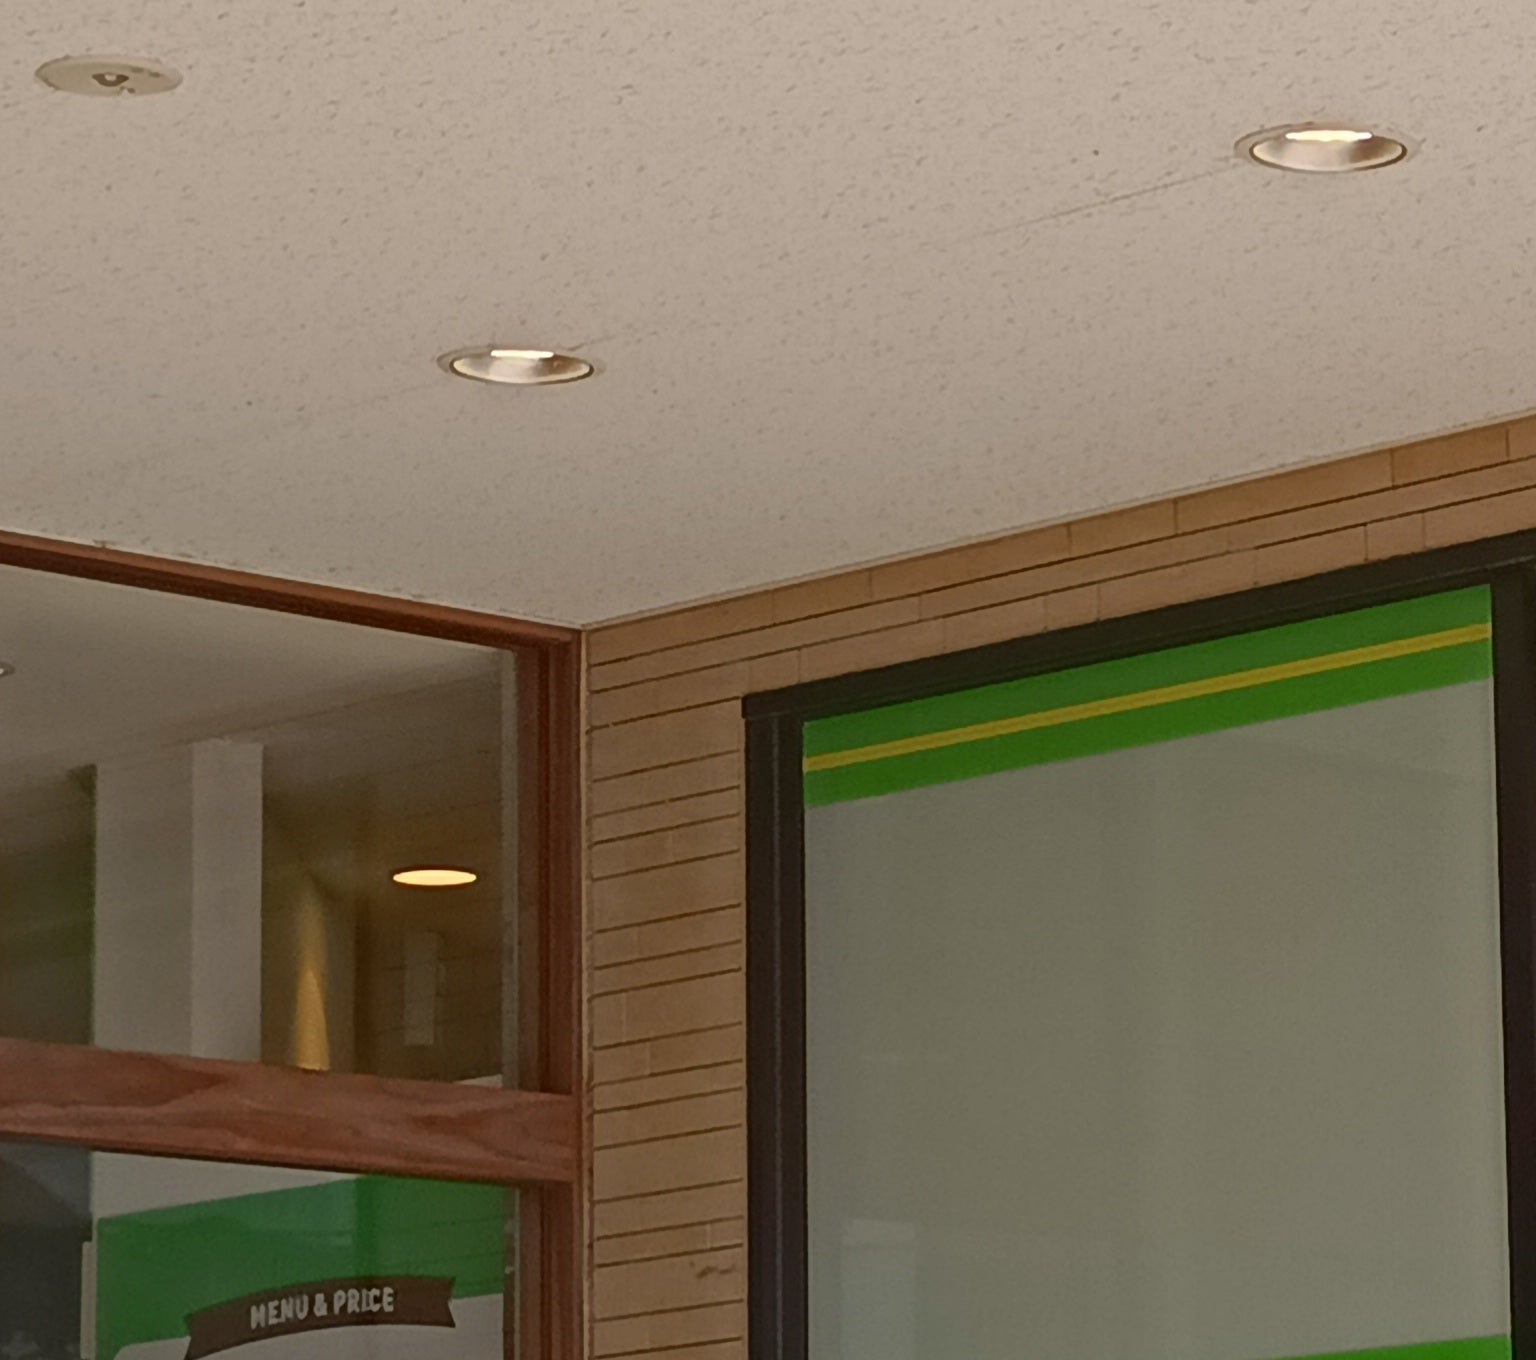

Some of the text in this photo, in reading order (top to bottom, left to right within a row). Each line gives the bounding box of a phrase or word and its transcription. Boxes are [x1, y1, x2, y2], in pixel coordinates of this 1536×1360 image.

[250, 1285, 395, 1330] MENU & PRICE
